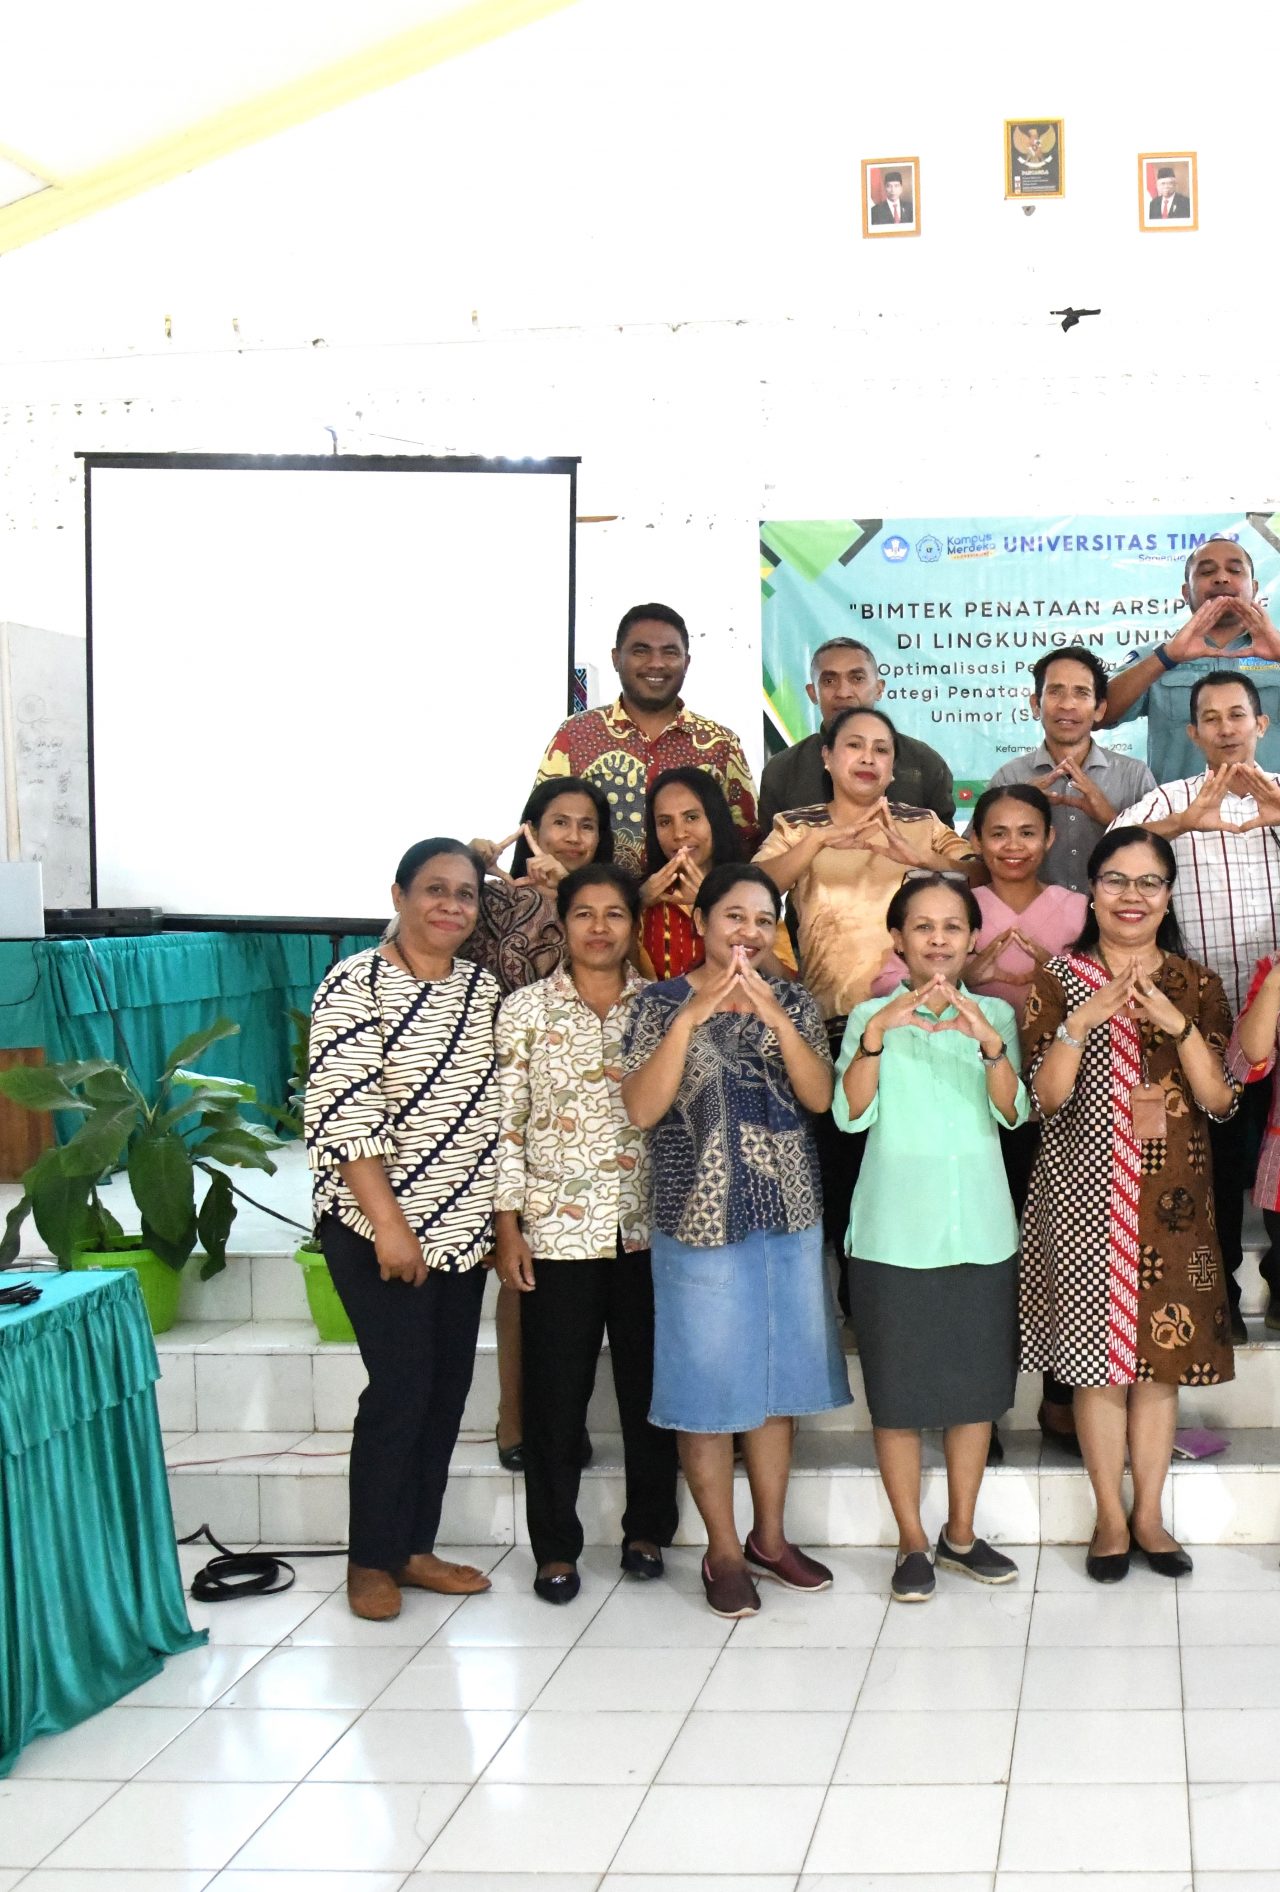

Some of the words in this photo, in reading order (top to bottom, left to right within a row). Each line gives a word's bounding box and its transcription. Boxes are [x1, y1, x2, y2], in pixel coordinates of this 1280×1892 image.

[1004, 533, 1157, 552] UNIVERSITAS
[849, 602, 952, 619] "BIMTEK
[966, 600, 1100, 618] PENATAAN
[1112, 598, 1185, 615] ARSIP
[898, 633, 920, 649] DI
[934, 631, 1104, 648] LINGKUNGAN
[1117, 629, 1180, 646] UNIM
[878, 660, 1006, 678] Optimalisasi
[886, 686, 938, 702] ategi
[948, 685, 1031, 699] Penataa
[931, 709, 1002, 723] Unimor
[995, 744, 1037, 753] Kefamen
